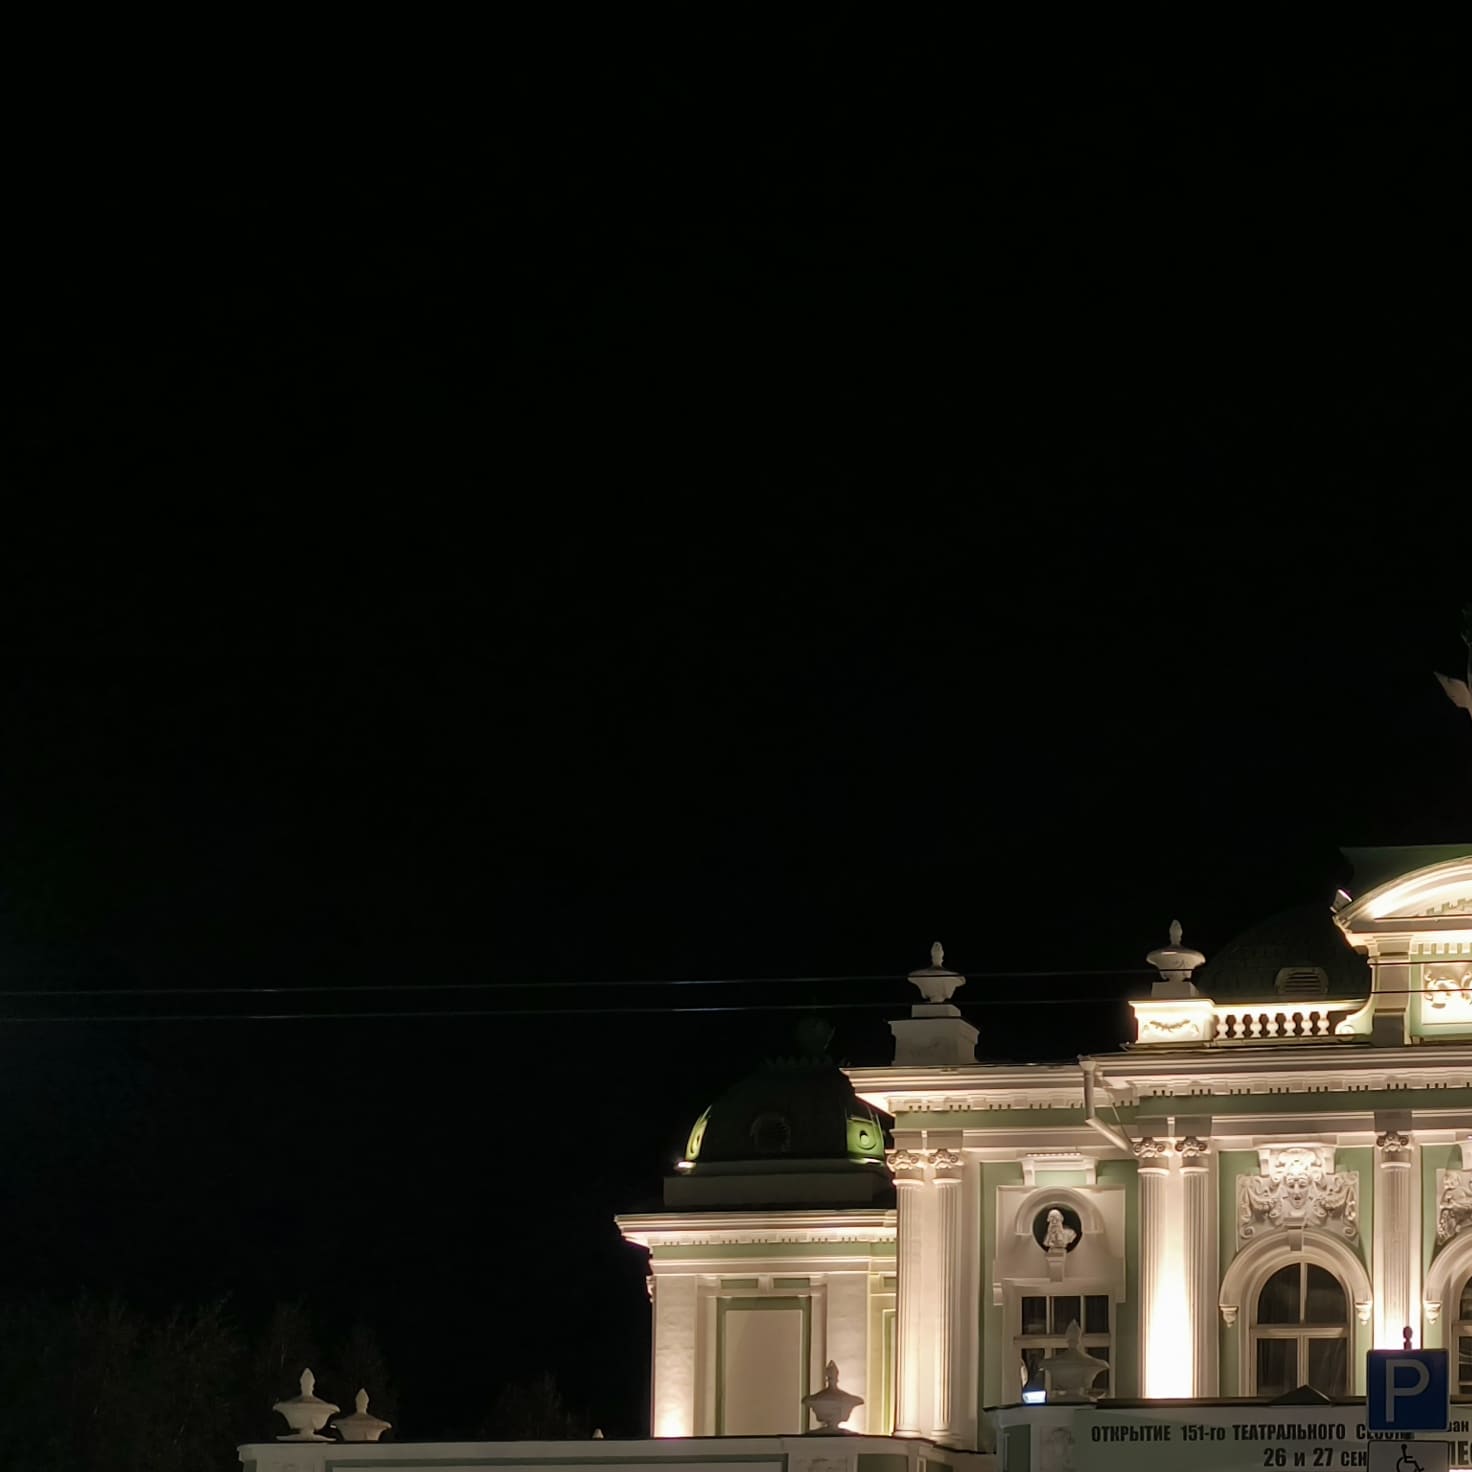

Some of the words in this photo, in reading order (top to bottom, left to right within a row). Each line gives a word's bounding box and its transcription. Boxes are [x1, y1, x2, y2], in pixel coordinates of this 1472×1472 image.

[1385, 1359, 1430, 1423] P
[1091, 1425, 1171, 1442] ОТКРЫТИЕ
[1180, 1424, 1226, 1441] 151-го
[1232, 1423, 1346, 1441] ТЕАТРАЛЬНОГО
[1263, 1447, 1287, 1467] 26
[1312, 1447, 1334, 1467] 27
[1340, 1450, 1367, 1467] СЕН
